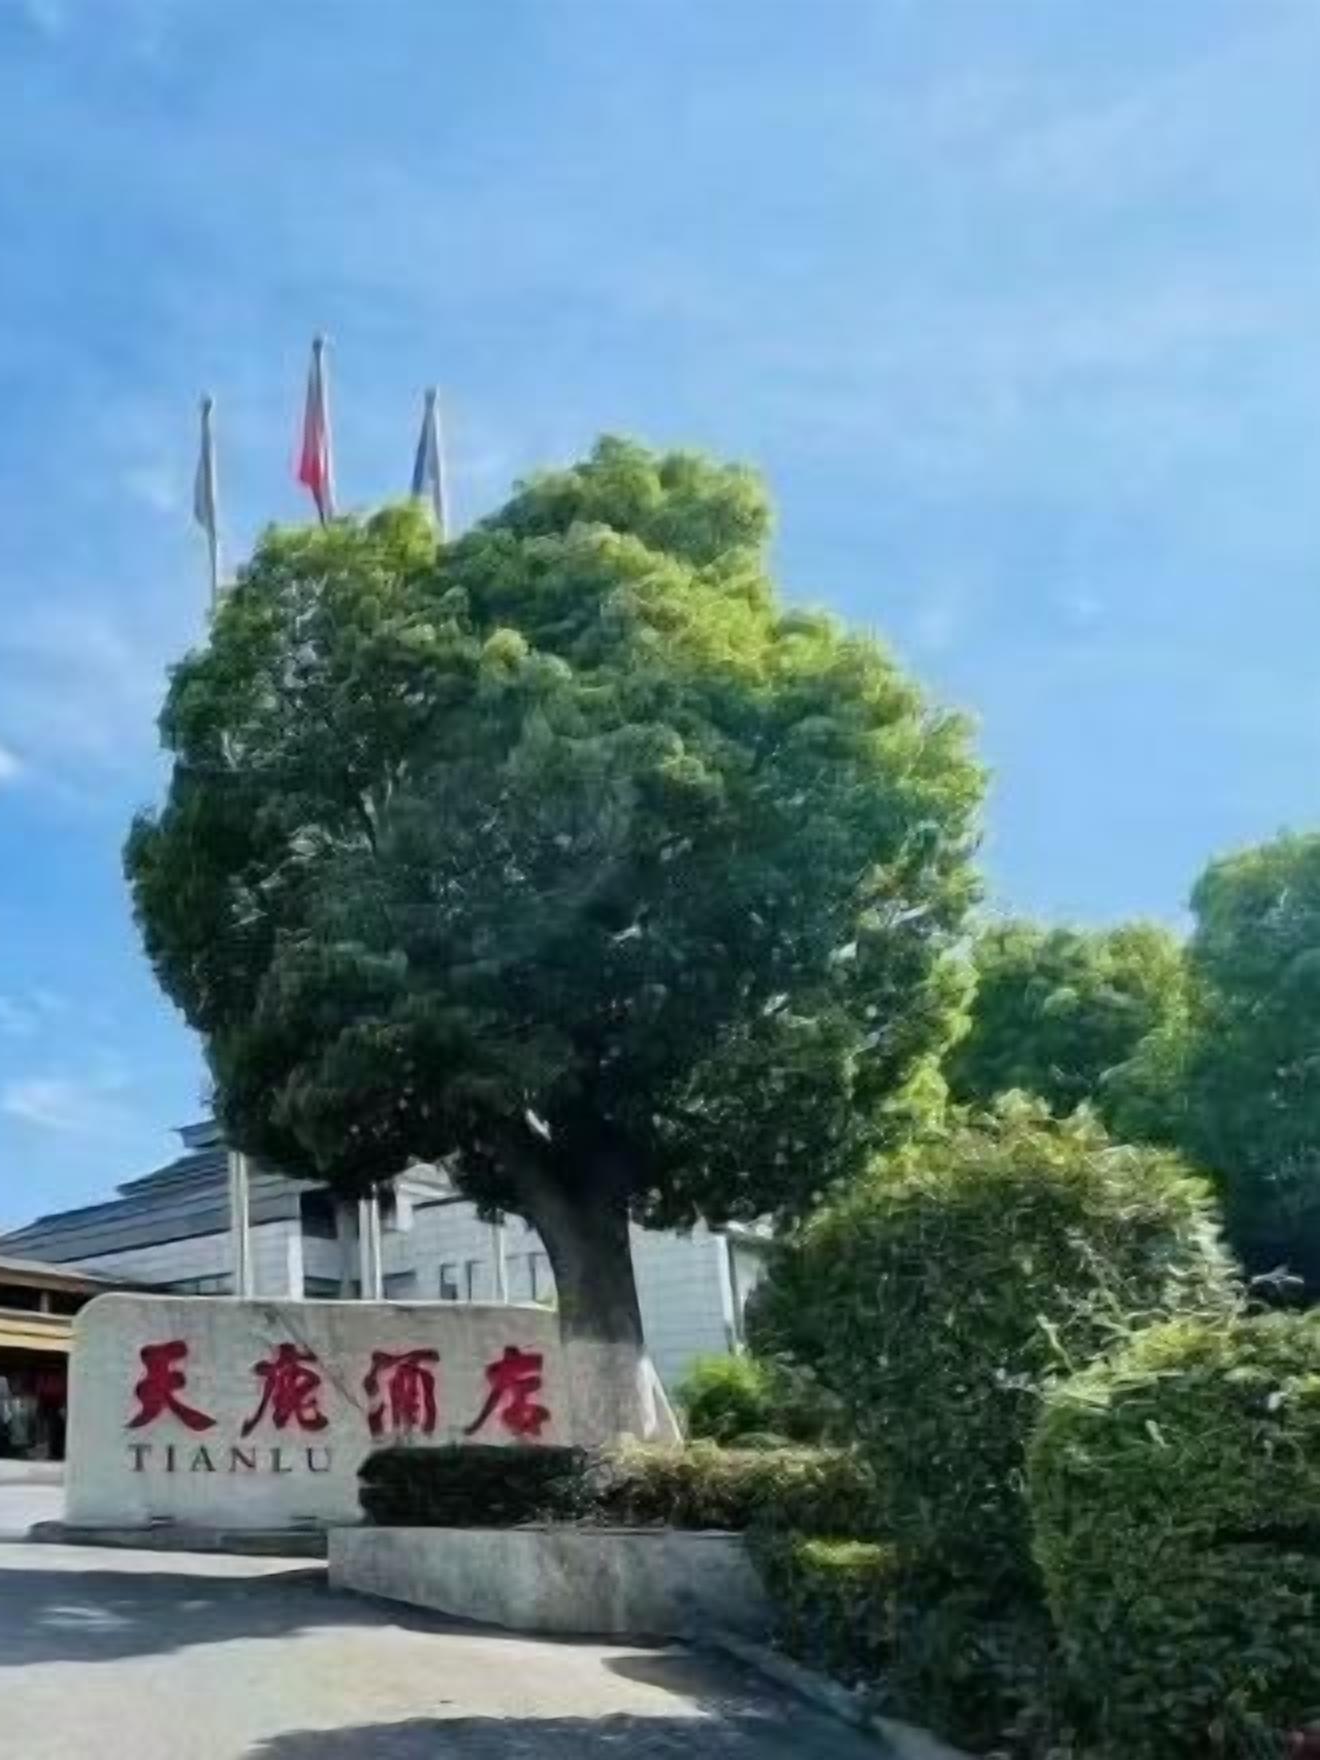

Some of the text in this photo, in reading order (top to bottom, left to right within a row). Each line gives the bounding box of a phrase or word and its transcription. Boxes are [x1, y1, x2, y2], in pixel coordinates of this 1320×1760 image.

[125, 1340, 551, 1437] 天鹿酒店
[128, 1444, 332, 1472] TIANLU
